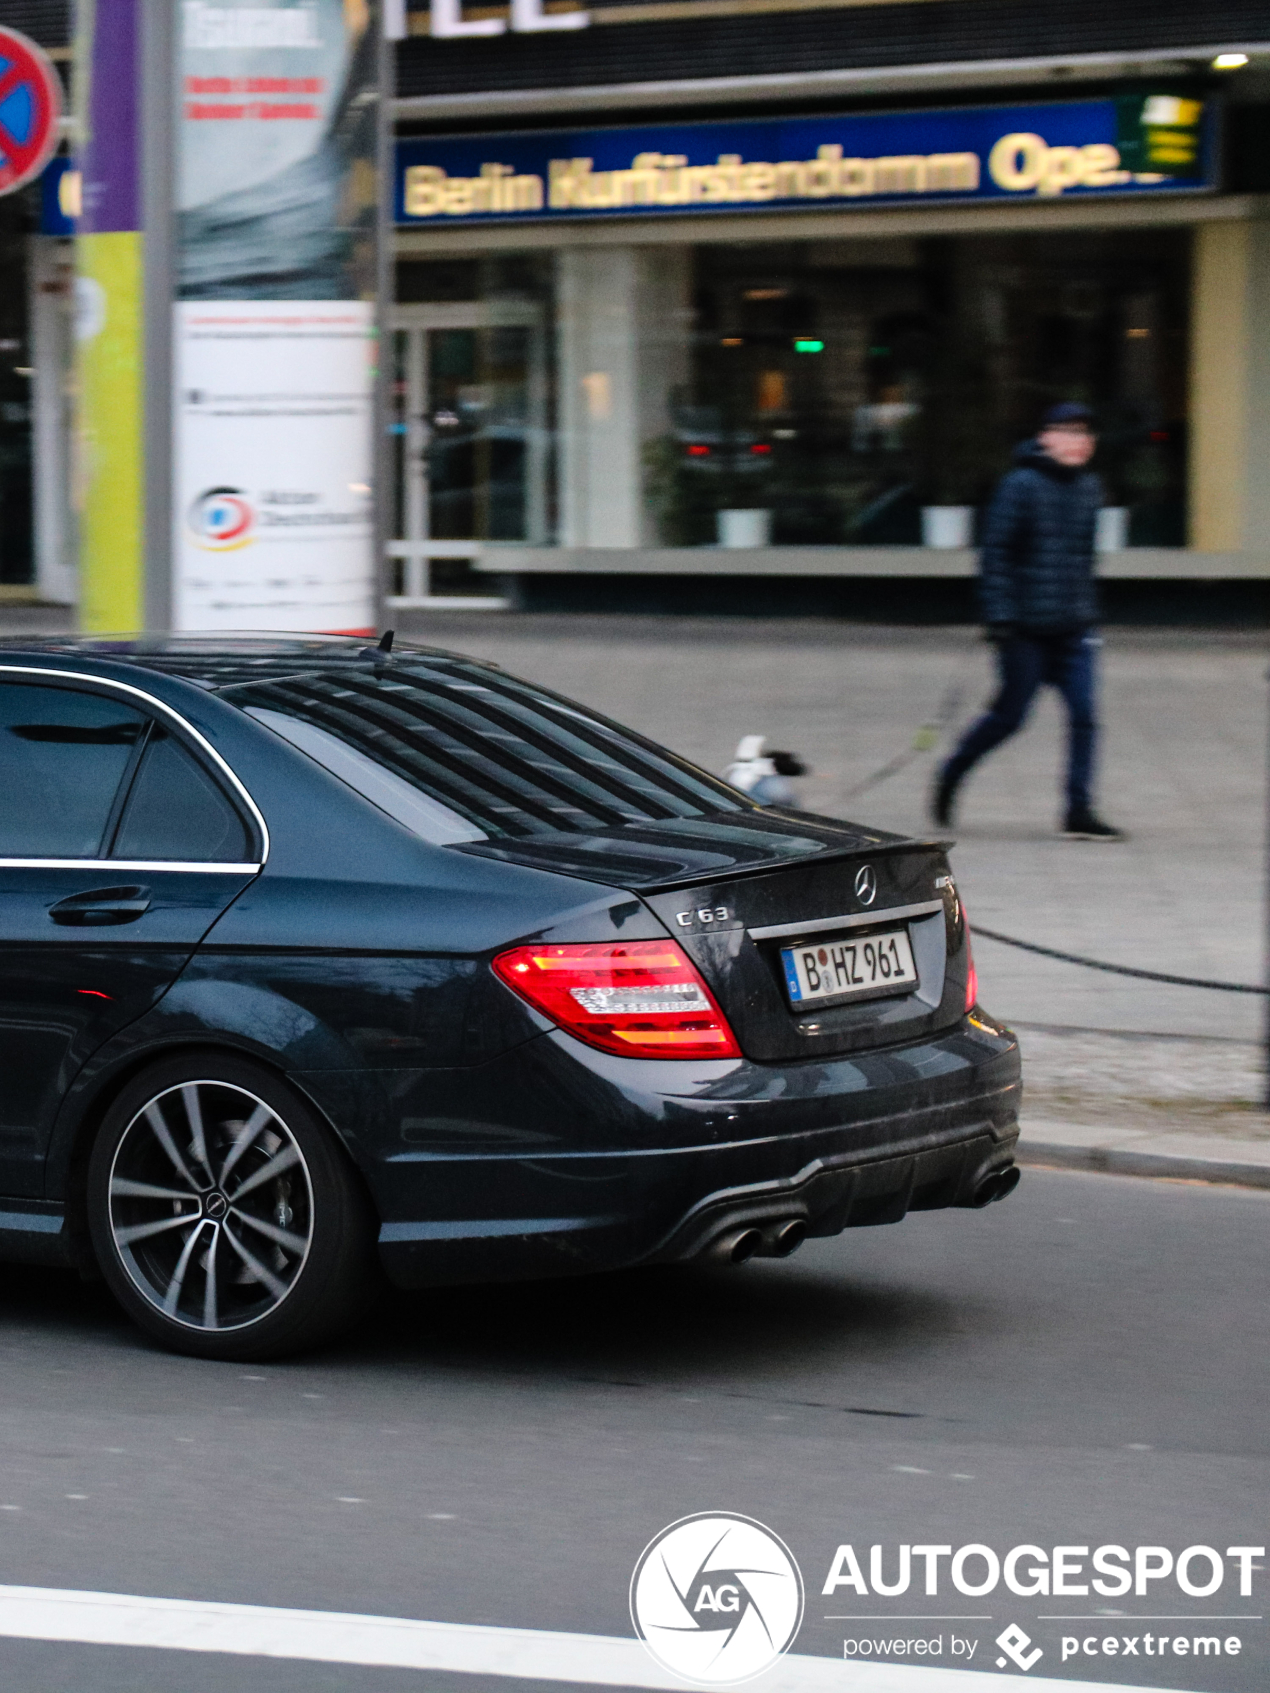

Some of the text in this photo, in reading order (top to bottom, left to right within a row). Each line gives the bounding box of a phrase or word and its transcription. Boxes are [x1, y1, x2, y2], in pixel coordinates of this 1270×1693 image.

[403, 162, 544, 216] Berlin
[547, 143, 979, 209] Kurfürstendamm
[676, 906, 729, 926] C 63
[802, 952, 821, 992] B
[831, 944, 864, 986] HZ
[863, 938, 905, 981] 961
